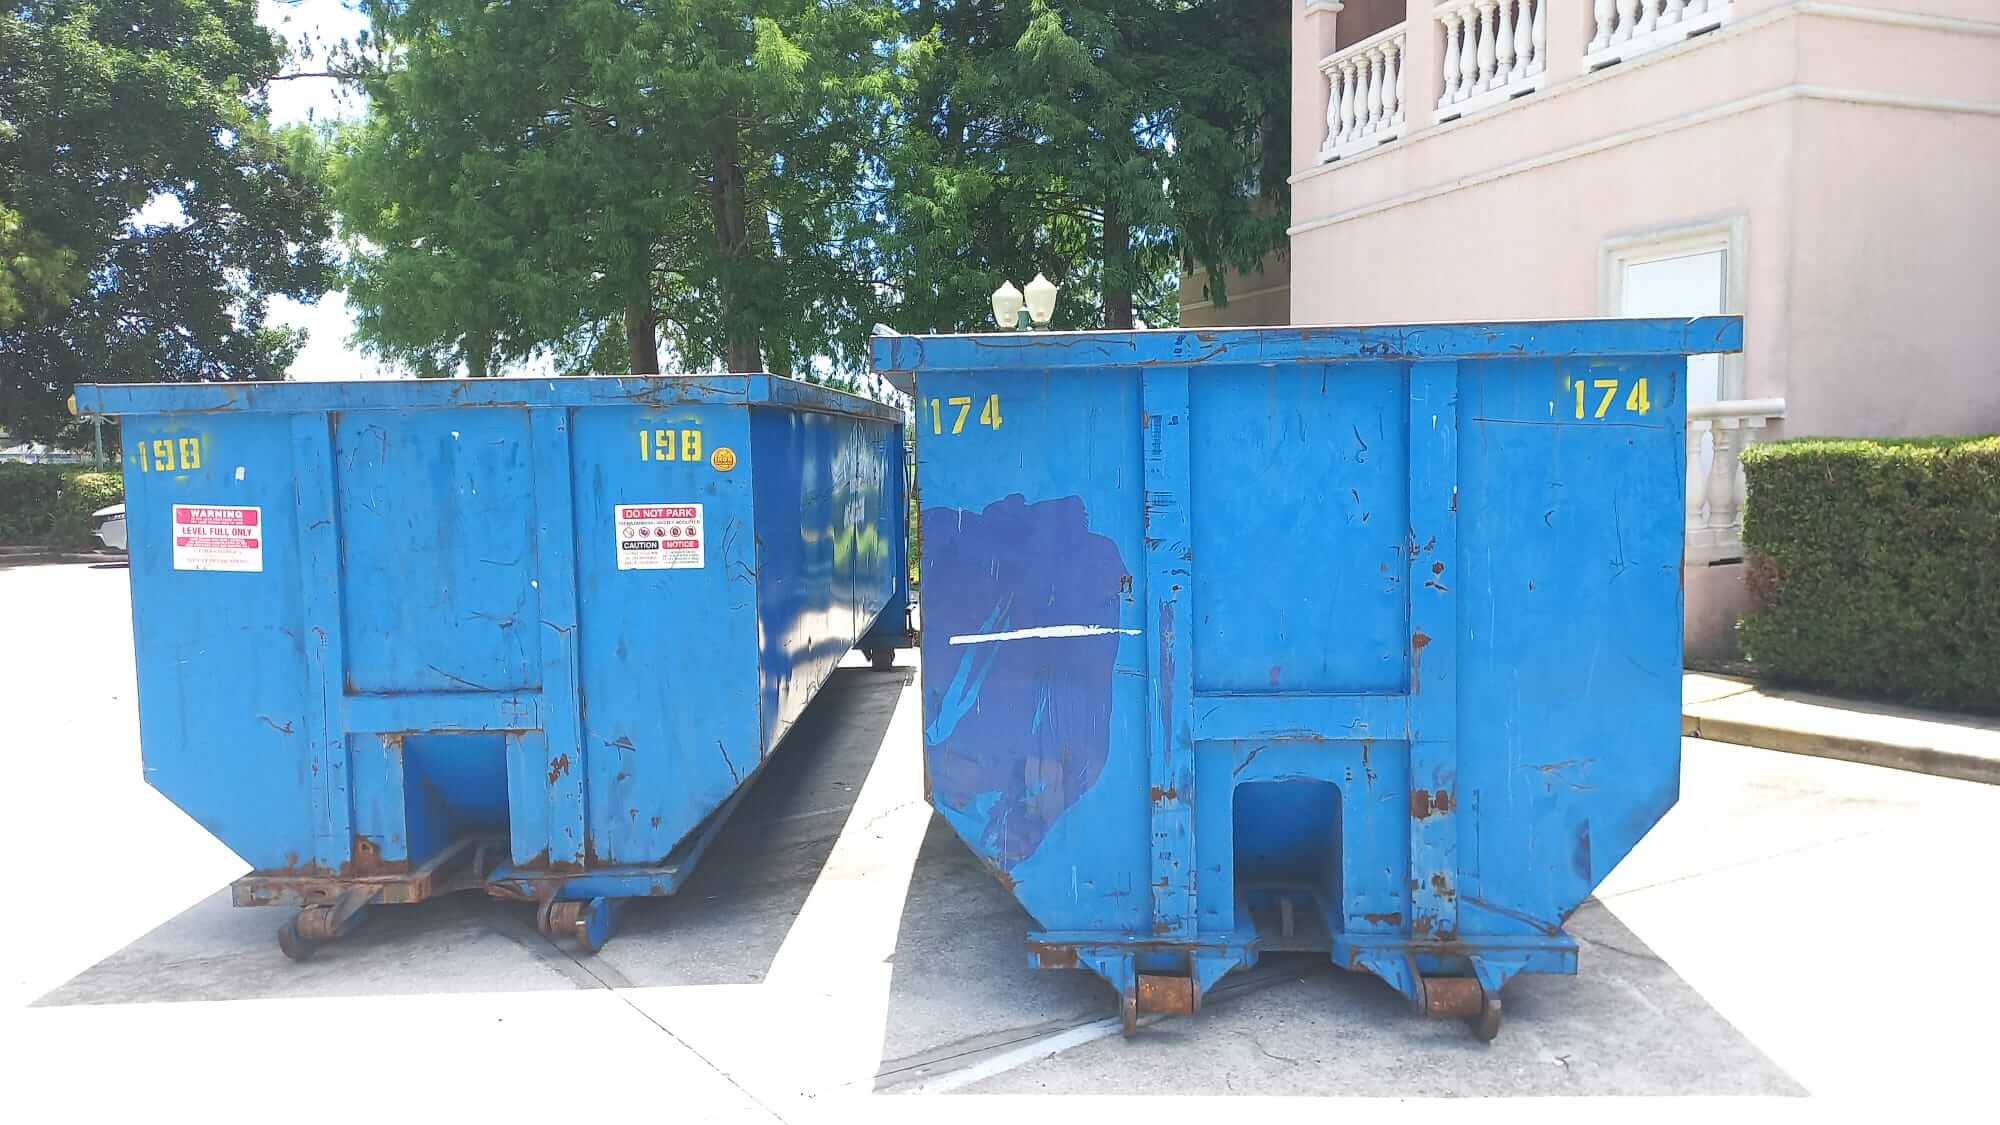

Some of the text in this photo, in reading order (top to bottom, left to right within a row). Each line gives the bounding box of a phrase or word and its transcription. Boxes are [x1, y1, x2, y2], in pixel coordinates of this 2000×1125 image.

[1574, 378, 1650, 419] 174
[930, 394, 1002, 435] 174
[639, 430, 702, 461] 198
[138, 438, 200, 472] 198
[190, 510, 243, 519] WARNING
[625, 508, 693, 519] DO NOT PARK
[182, 527, 252, 537] LEVEL FULL ONLY
[623, 542, 657, 550] CAUTION
[666, 540, 695, 549] NOTICE
